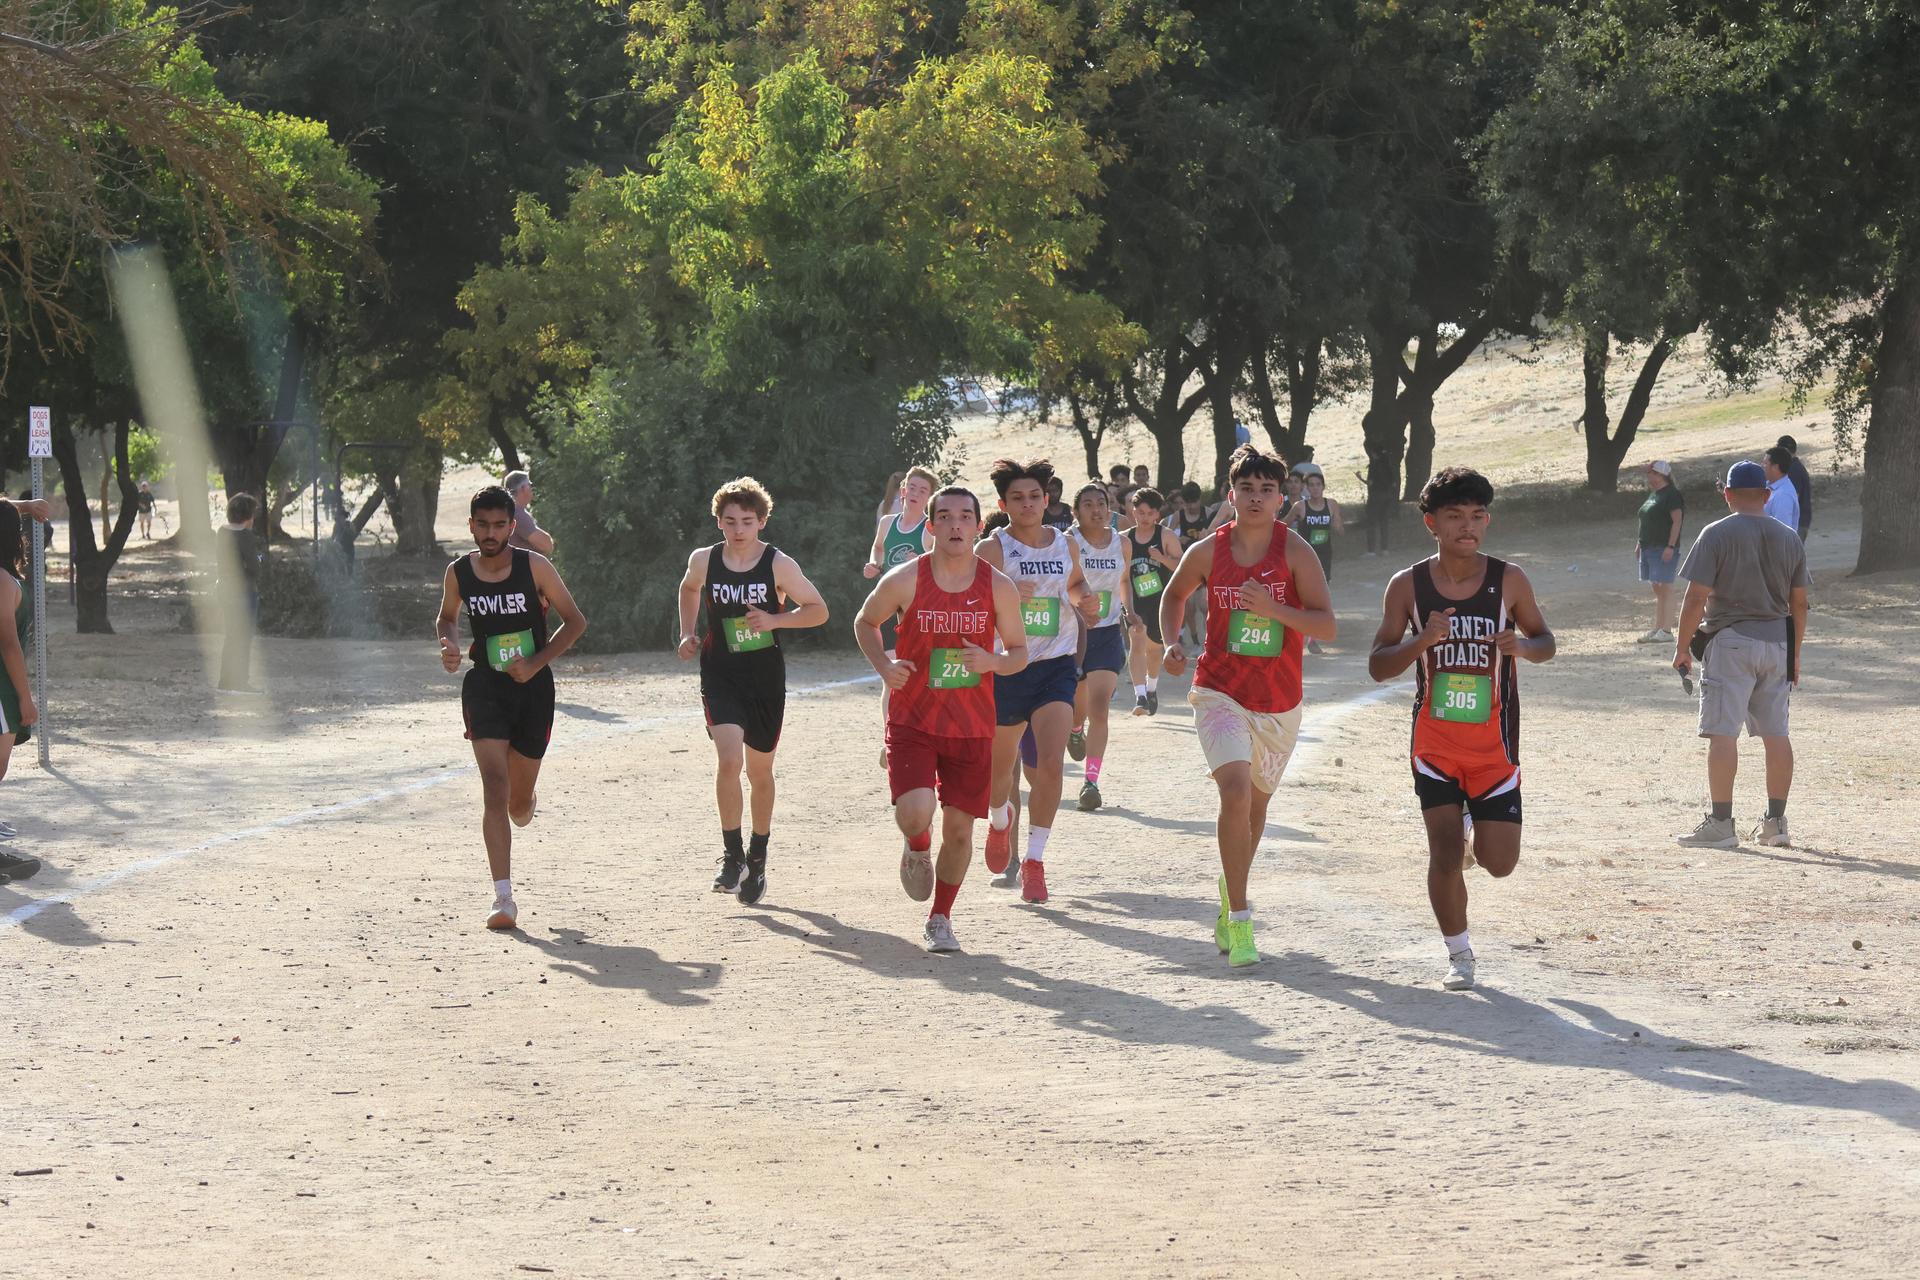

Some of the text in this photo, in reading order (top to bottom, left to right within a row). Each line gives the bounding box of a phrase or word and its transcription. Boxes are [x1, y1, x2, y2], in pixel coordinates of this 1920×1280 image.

[32, 411, 48, 420] DOGS
[36, 420, 45, 428] ON
[31, 429, 49, 437] LEASH
[1020, 560, 1064, 575] AZTECS
[1085, 558, 1116, 569] AZTECS
[712, 583, 768, 605] FOWLER
[469, 593, 527, 616] FOWLER
[917, 610, 989, 634] TRIBE
[1024, 611, 1050, 626] 549
[1240, 627, 1271, 645] 294
[1433, 643, 1489, 669] TOADS
[1445, 690, 1477, 709] 305
